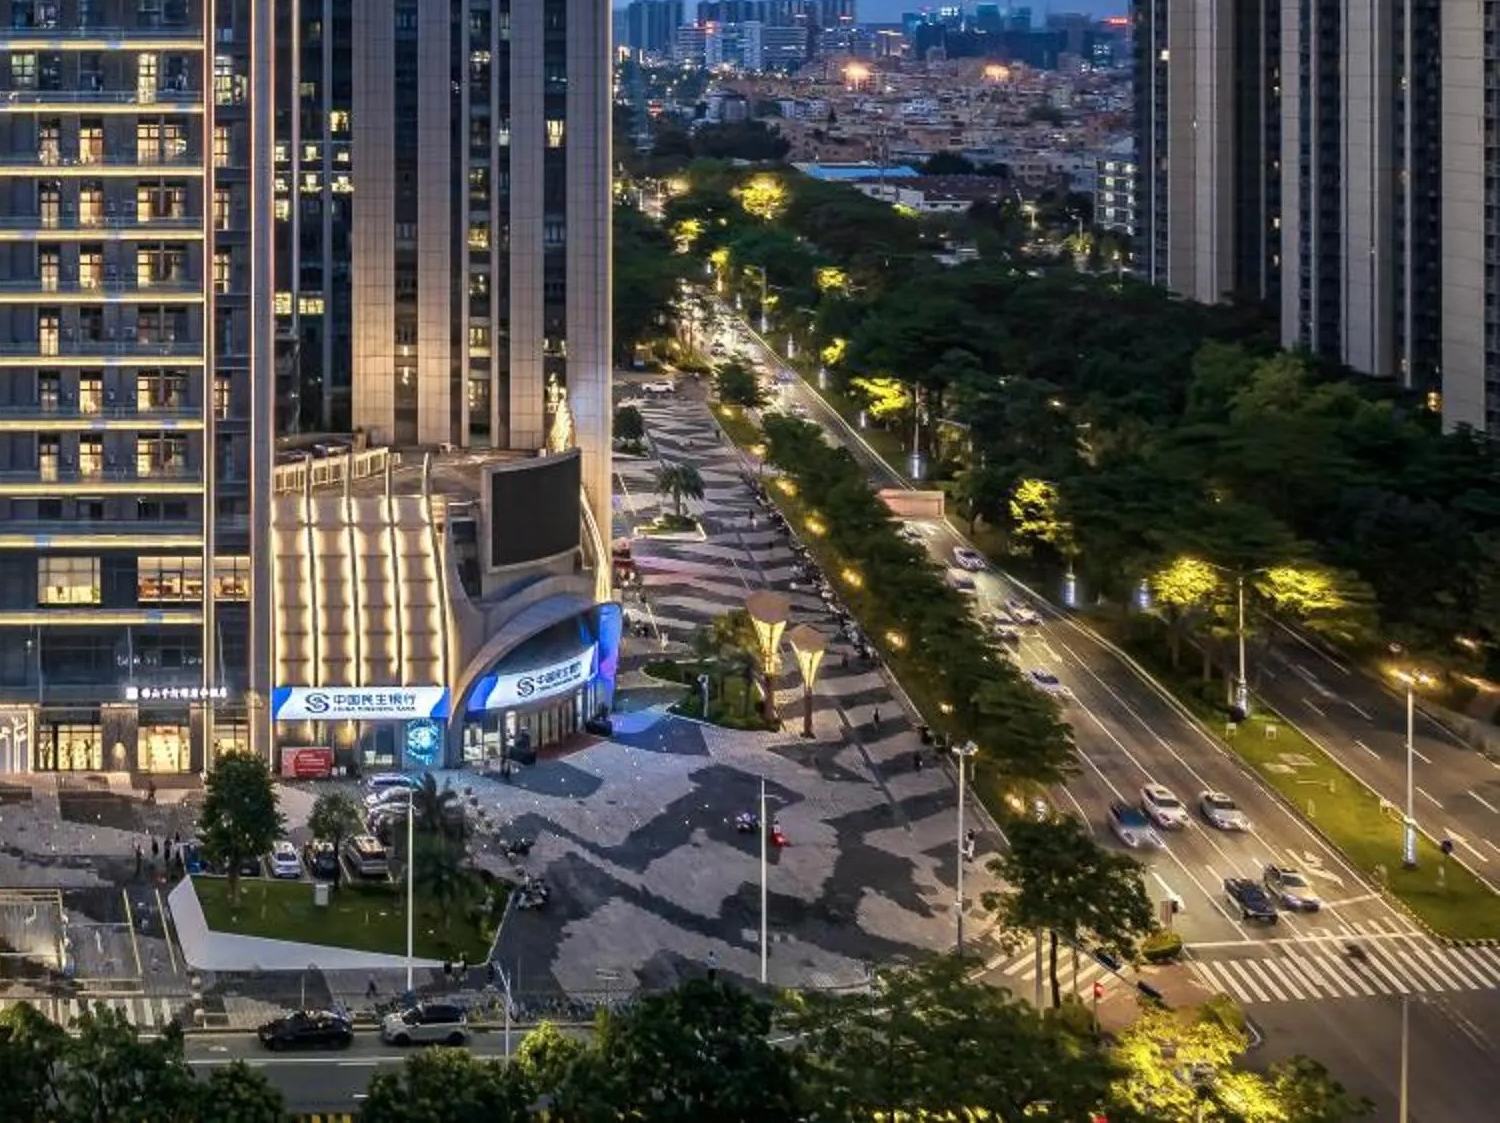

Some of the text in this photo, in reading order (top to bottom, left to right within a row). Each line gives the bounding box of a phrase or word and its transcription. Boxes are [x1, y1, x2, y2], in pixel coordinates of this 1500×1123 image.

[333, 692, 417, 706] 中国民生银行
